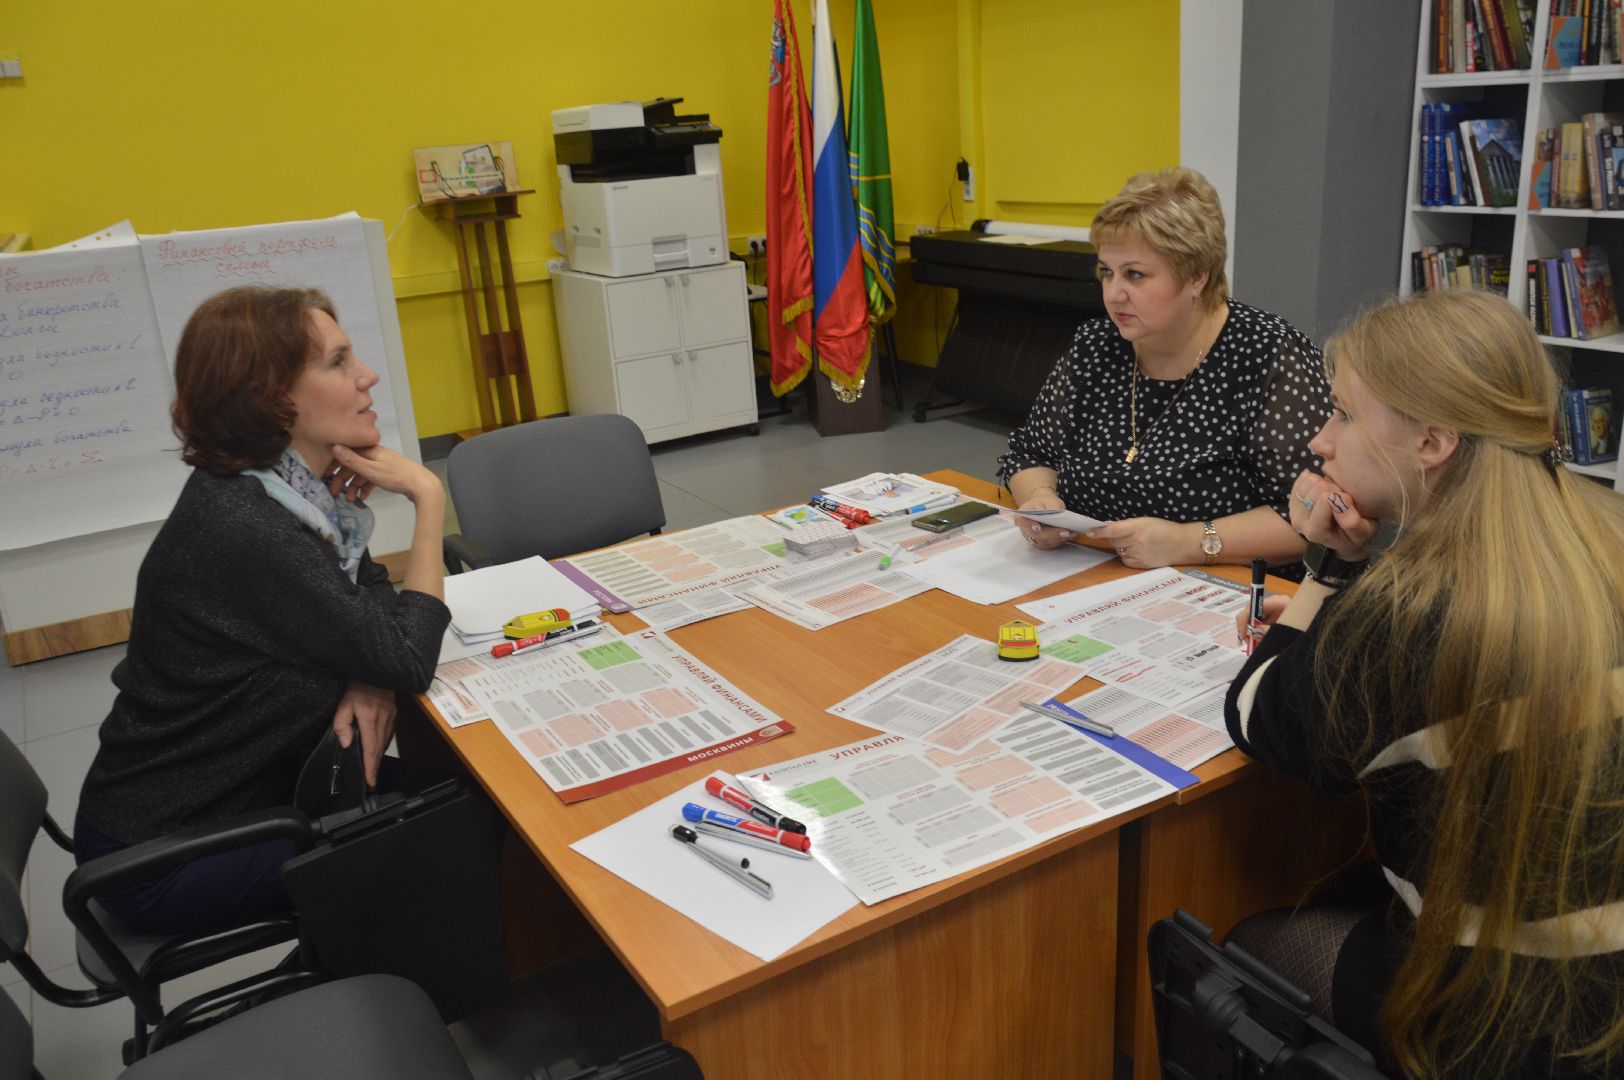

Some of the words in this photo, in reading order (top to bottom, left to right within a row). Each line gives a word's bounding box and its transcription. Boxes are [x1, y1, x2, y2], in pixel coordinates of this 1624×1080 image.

[1064, 600, 1121, 624] УПРАВЛЯЙ
[1121, 576, 1186, 603] ФИНАНСАМИ
[672, 654, 717, 686] УПРАВЛЯЙ
[712, 684, 768, 723] ФИНАНСАМИ
[687, 737, 754, 762] МОСКВИНЫ
[829, 735, 905, 760] УПРАВЛЯ
